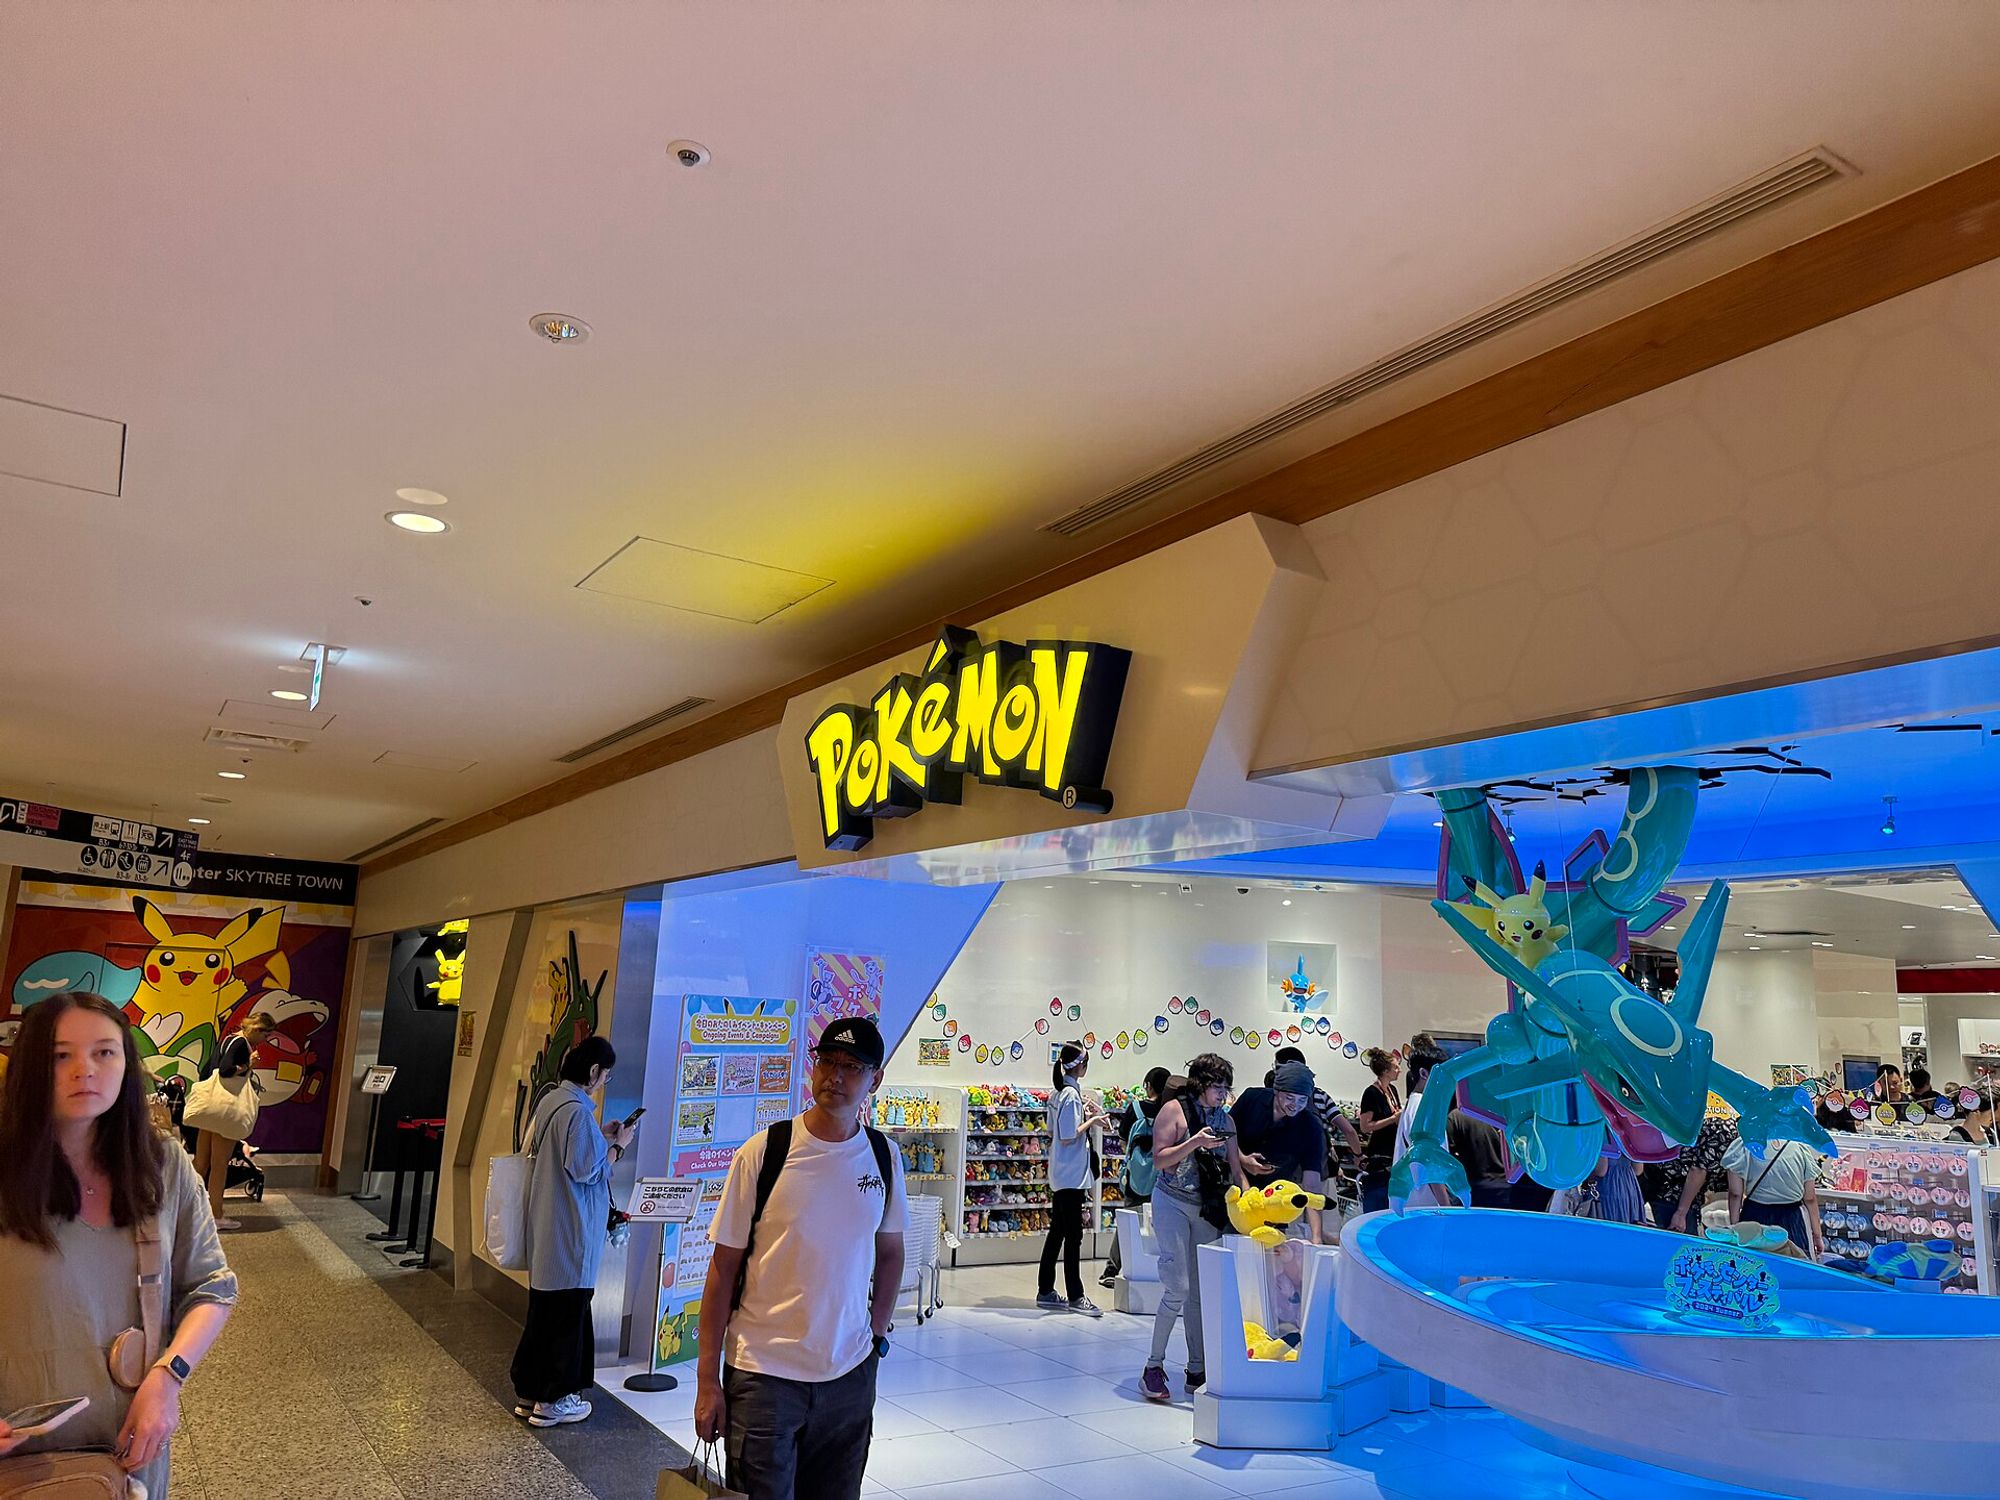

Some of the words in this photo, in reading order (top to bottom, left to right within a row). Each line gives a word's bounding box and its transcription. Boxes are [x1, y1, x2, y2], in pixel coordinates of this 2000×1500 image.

[180, 849, 192, 861] 4F
[226, 868, 293, 886] SKYTREE
[297, 873, 344, 891] TOWN
[702, 1030, 727, 1041] Ongoing
[727, 1031, 744, 1039] Events
[751, 1031, 780, 1042] Campaigns
[834, 1035, 856, 1045] adidas
[690, 1162, 707, 1170] Check
[707, 1160, 717, 1168] Our
